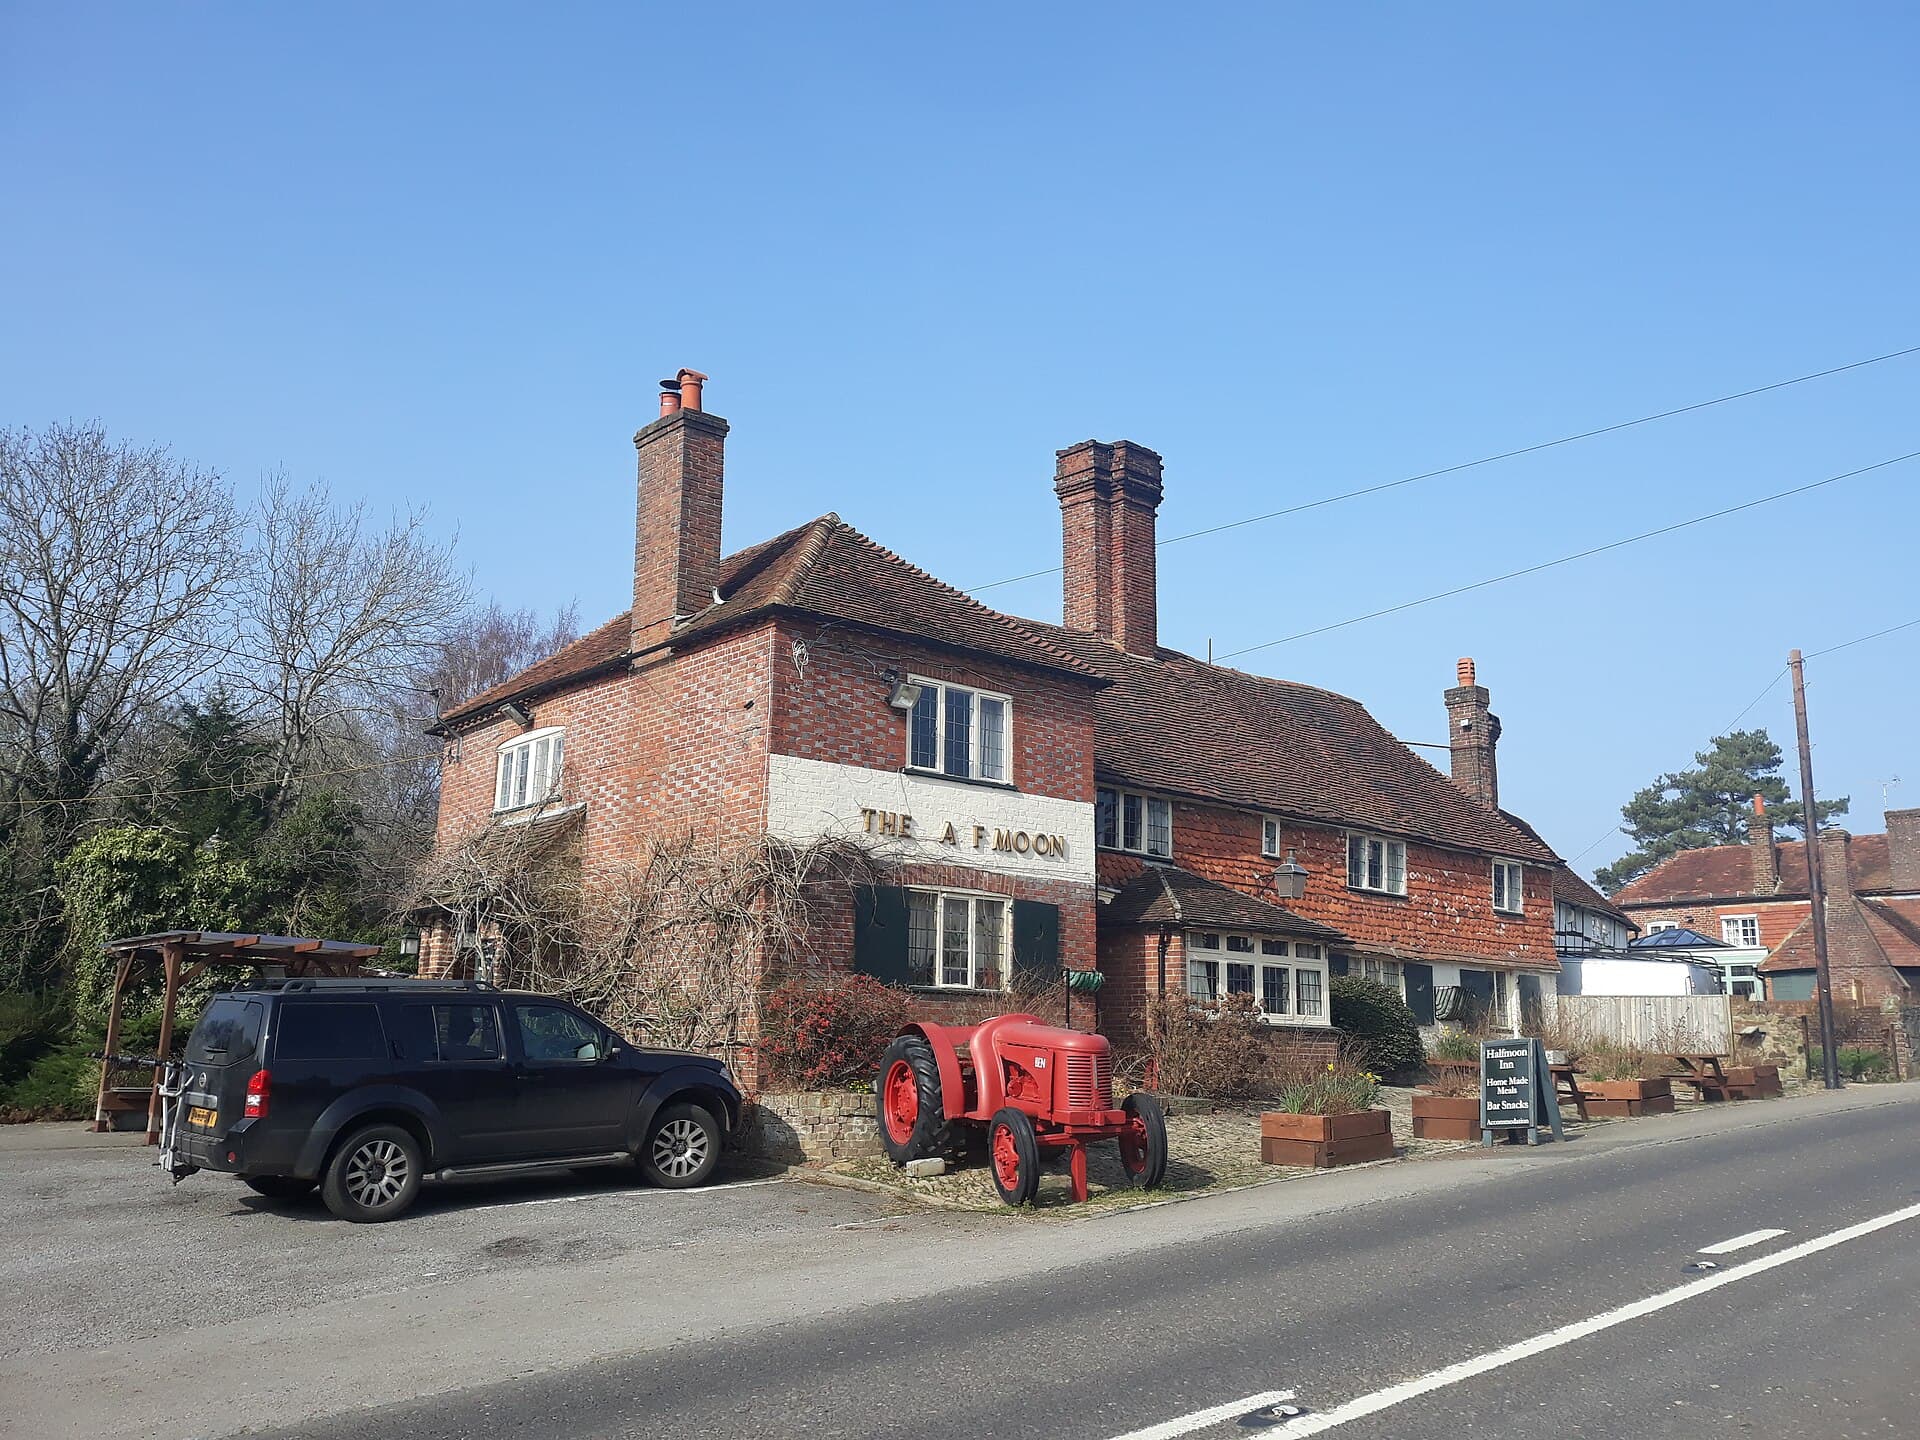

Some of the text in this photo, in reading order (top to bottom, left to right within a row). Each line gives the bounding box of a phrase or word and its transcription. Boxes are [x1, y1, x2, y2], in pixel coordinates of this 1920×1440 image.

[861, 808, 912, 838] THE
[1486, 1048, 1528, 1059] Halfmoon
[1499, 1060, 1515, 1069] Inn
[1486, 1076, 1529, 1086] Home Made
[1496, 1086, 1518, 1095] Meals
[1486, 1099, 1529, 1111] Bar Snacks
